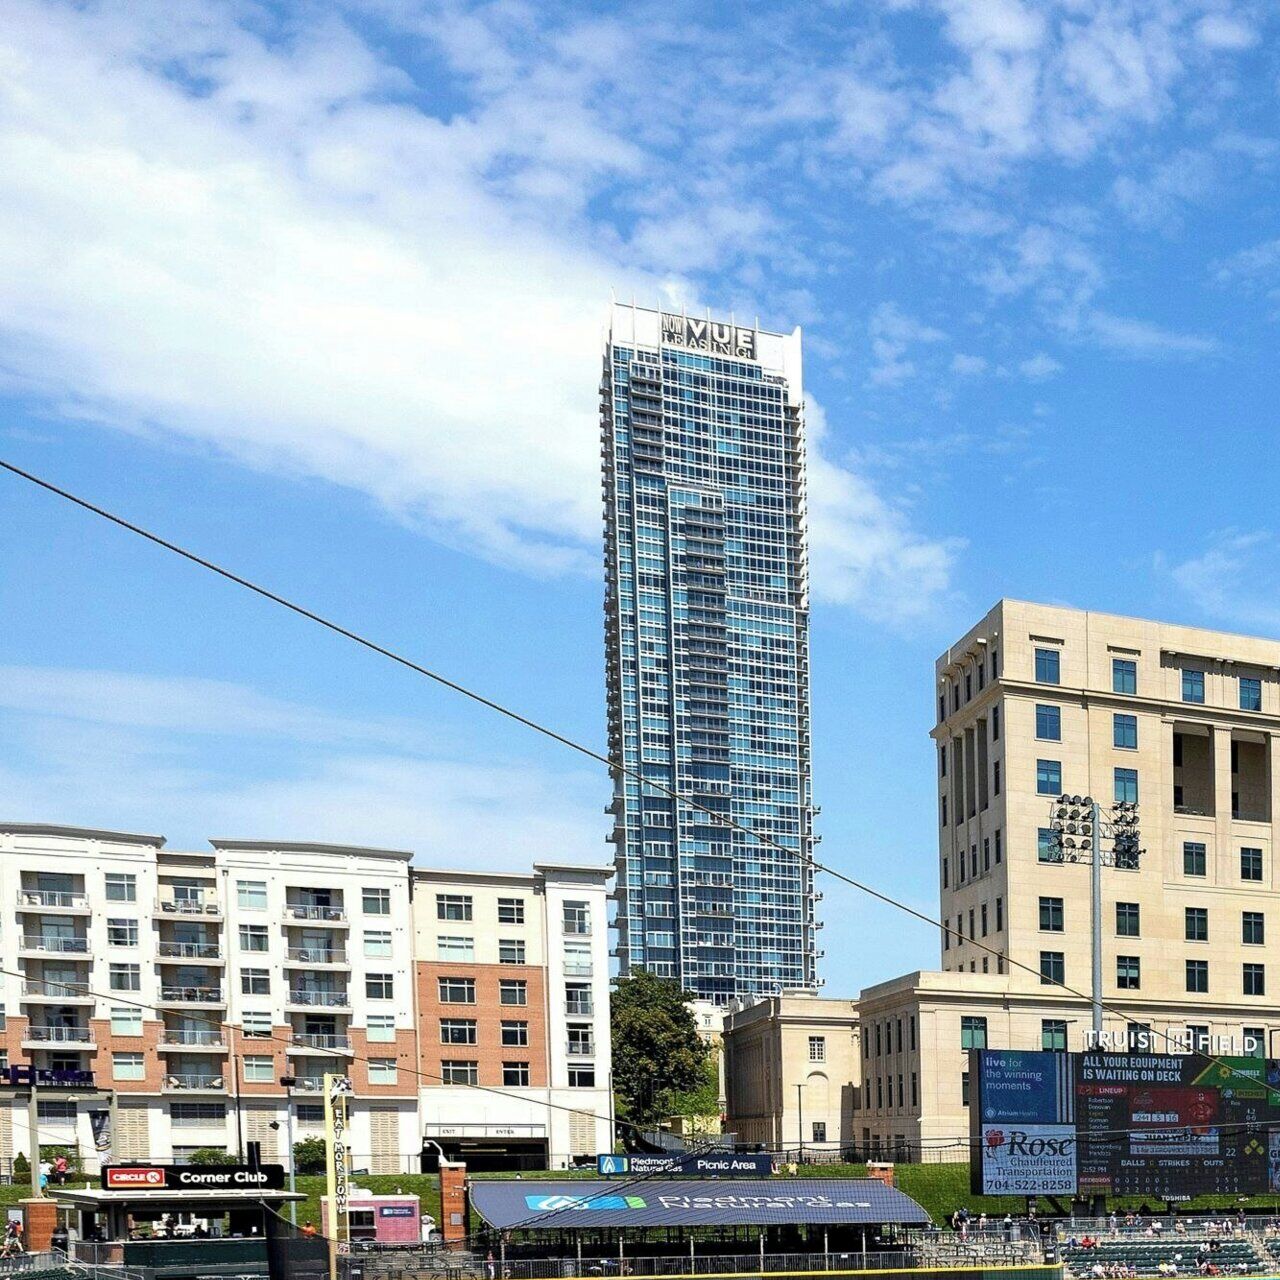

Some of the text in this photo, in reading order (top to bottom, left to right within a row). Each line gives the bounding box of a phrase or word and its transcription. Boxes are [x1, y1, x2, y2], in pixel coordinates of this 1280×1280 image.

[662, 315, 684, 335] NOW
[687, 319, 754, 349] VUE
[1084, 1029, 1258, 1051] TRUIST FIELD
[986, 1057, 1022, 1067] live for
[1083, 1056, 1183, 1069] ALL YOUR EQUIPMENT
[986, 1069, 1042, 1081] the winning
[1083, 1068, 1181, 1081] IS WAITING ON DECK
[986, 1081, 1031, 1090] moments
[334, 1109, 345, 1139] EAT
[1007, 1131, 1074, 1156] Rose
[334, 1141, 345, 1171] MOR
[1225, 1148, 1236, 1156] 22
[630, 1157, 674, 1166] Piedmont
[630, 1160, 757, 1173] Natural Gas Picnic Area
[1010, 1157, 1072, 1167] Chauffeured
[112, 1173, 146, 1182] CIRCLE
[180, 1171, 268, 1184] Corner Club
[995, 1167, 1072, 1177] Transportation
[986, 1180, 1072, 1190] 704-522-8258
[335, 1176, 346, 1215] FOWL
[658, 1194, 832, 1203] Piedmont
[662, 1200, 795, 1209] Natural
